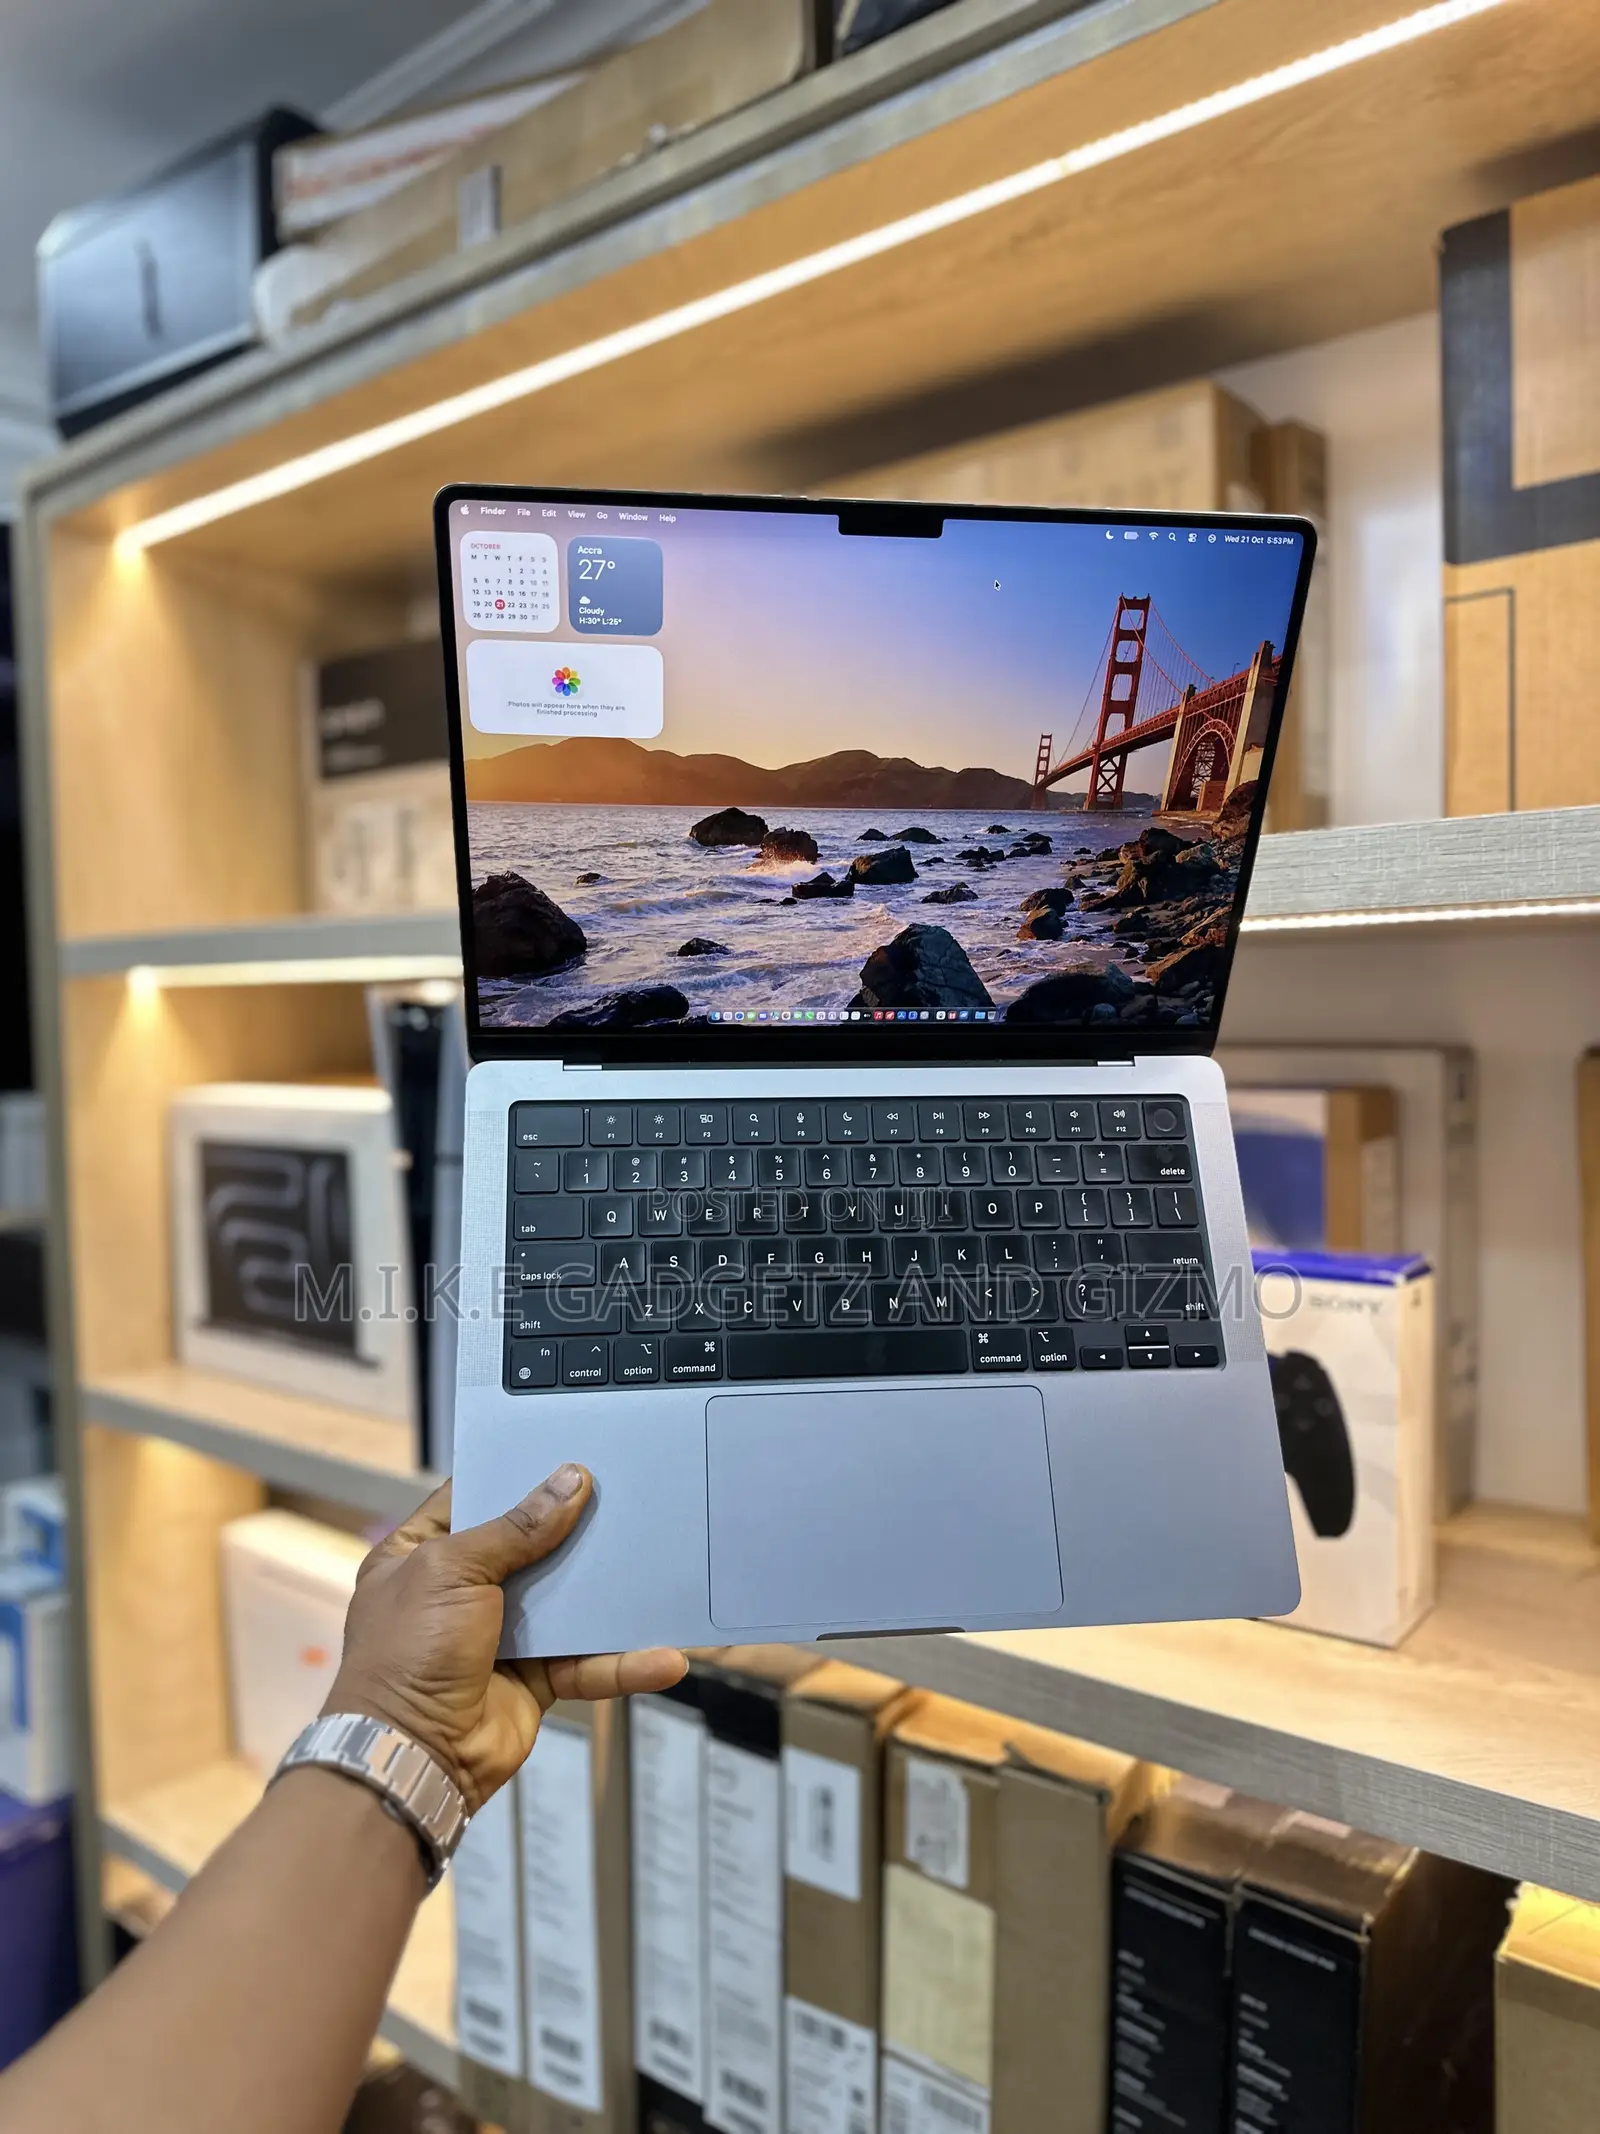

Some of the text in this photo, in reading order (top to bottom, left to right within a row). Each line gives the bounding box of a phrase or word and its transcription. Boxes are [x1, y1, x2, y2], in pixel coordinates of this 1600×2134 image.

[481, 507, 506, 515] Finder
[542, 509, 556, 517] Edit
[597, 512, 608, 520] Go
[619, 512, 648, 521] Window
[659, 514, 676, 523] Help
[578, 546, 602, 555] Accra
[579, 559, 615, 580] 27°
[579, 607, 604, 615] Cloudy
[728, 1170, 736, 1181] 4
[776, 1170, 783, 1180] 5
[823, 1169, 831, 1179] 6
[870, 1168, 877, 1178] 7
[916, 1167, 924, 1178] 8
[962, 1167, 970, 1177] 9
[1008, 1166, 1016, 1176] 0
[1160, 1167, 1185, 1175] delete
[583, 1173, 589, 1184] 1
[632, 1173, 640, 1183] 2
[680, 1171, 688, 1182] 3
[801, 1207, 809, 1218] T
[848, 1206, 857, 1217] Y
[895, 1205, 904, 1216] U
[988, 1203, 997, 1214] O
[1035, 1203, 1043, 1213] P
[607, 1211, 617, 1222] Q
[654, 1210, 667, 1221] W
[706, 1209, 713, 1220] E
[754, 1208, 761, 1219] R
[521, 1225, 535, 1233] tab
[768, 1254, 775, 1264] F
[815, 1253, 824, 1264] G
[862, 1252, 871, 1262] H
[911, 1250, 918, 1261] J
[958, 1250, 966, 1260] K
[1006, 1249, 1012, 1259] L
[619, 1258, 629, 1269] A
[670, 1256, 678, 1267] S
[719, 1256, 727, 1266] D
[521, 1271, 562, 1282] caps lock
[792, 1300, 801, 1311] V
[842, 1299, 850, 1310] B
[889, 1298, 898, 1309] N
[937, 1297, 947, 1307] M
[1186, 1302, 1205, 1311] shift
[645, 1305, 653, 1316] Z
[695, 1303, 704, 1315] X
[744, 1302, 753, 1313] C
[520, 1320, 541, 1330] shift
[540, 1348, 550, 1356] fn
[980, 1353, 1021, 1363] command
[1040, 1352, 1067, 1364] option
[569, 1368, 601, 1378] control
[624, 1366, 652, 1377] option
[673, 1364, 716, 1374] command
